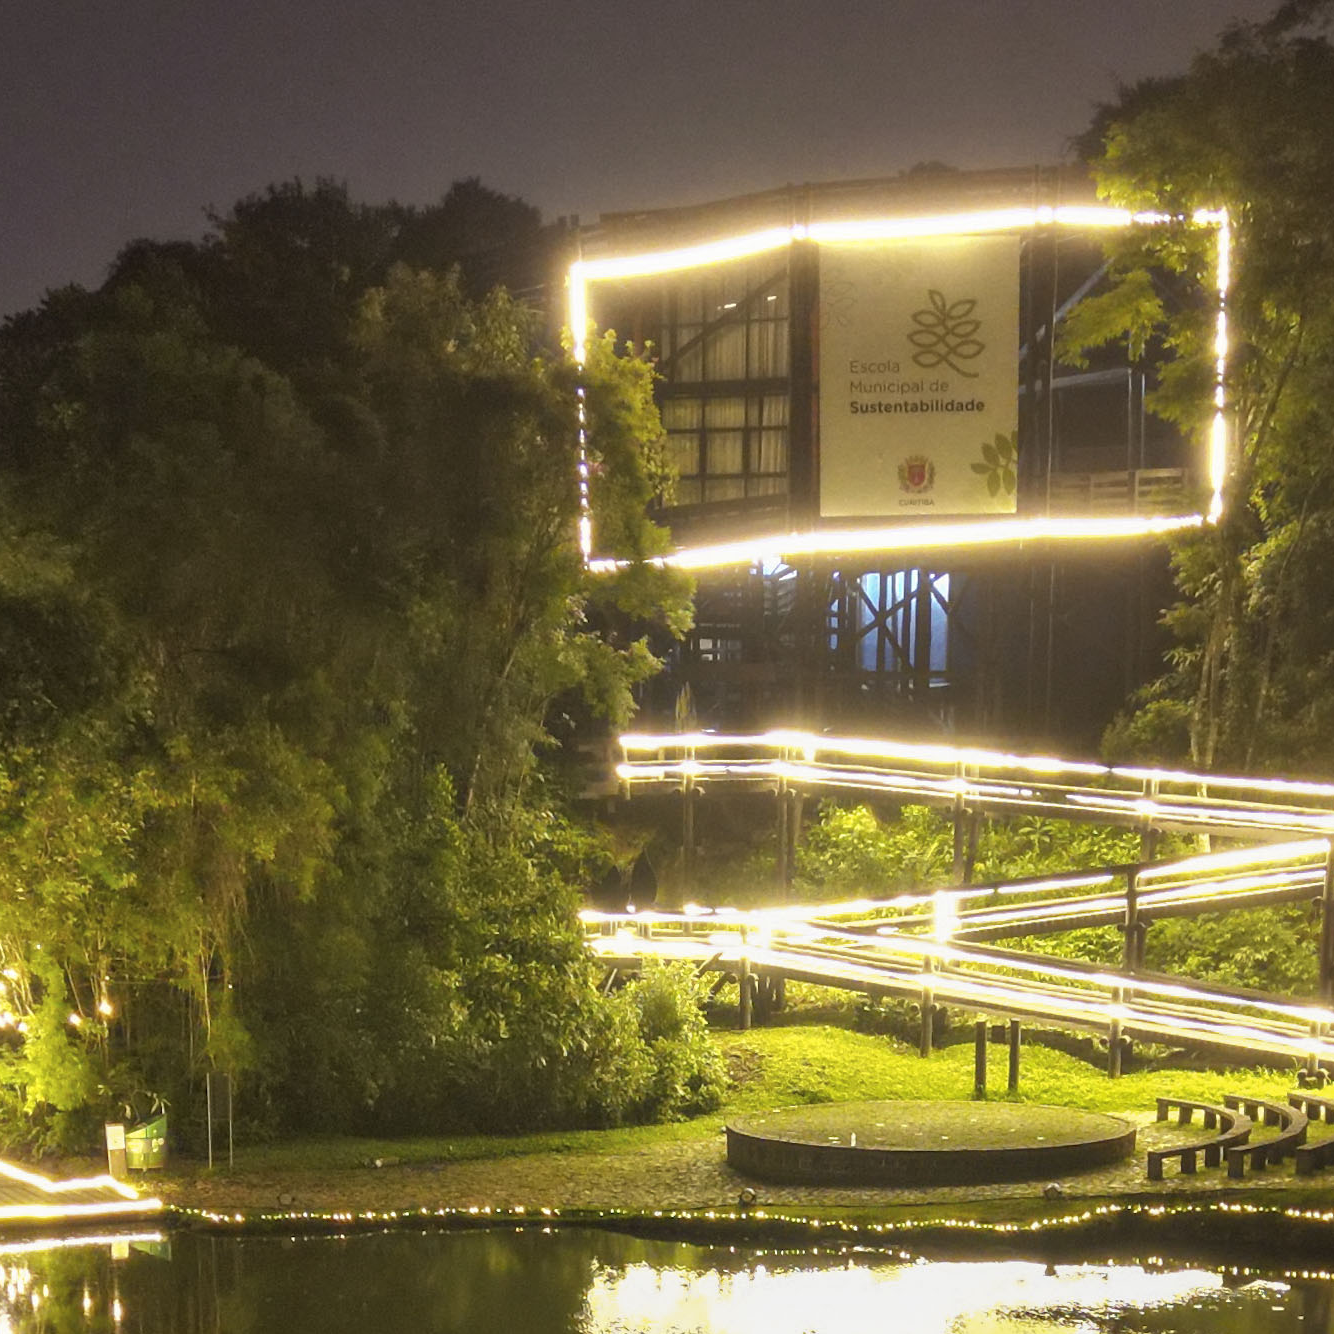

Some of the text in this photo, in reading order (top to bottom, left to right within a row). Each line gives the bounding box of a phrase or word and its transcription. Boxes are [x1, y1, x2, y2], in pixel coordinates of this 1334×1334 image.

[850, 360, 900, 374] Escola
[850, 380, 949, 395] Municipal de
[850, 399, 985, 414] Sustentabilidade
